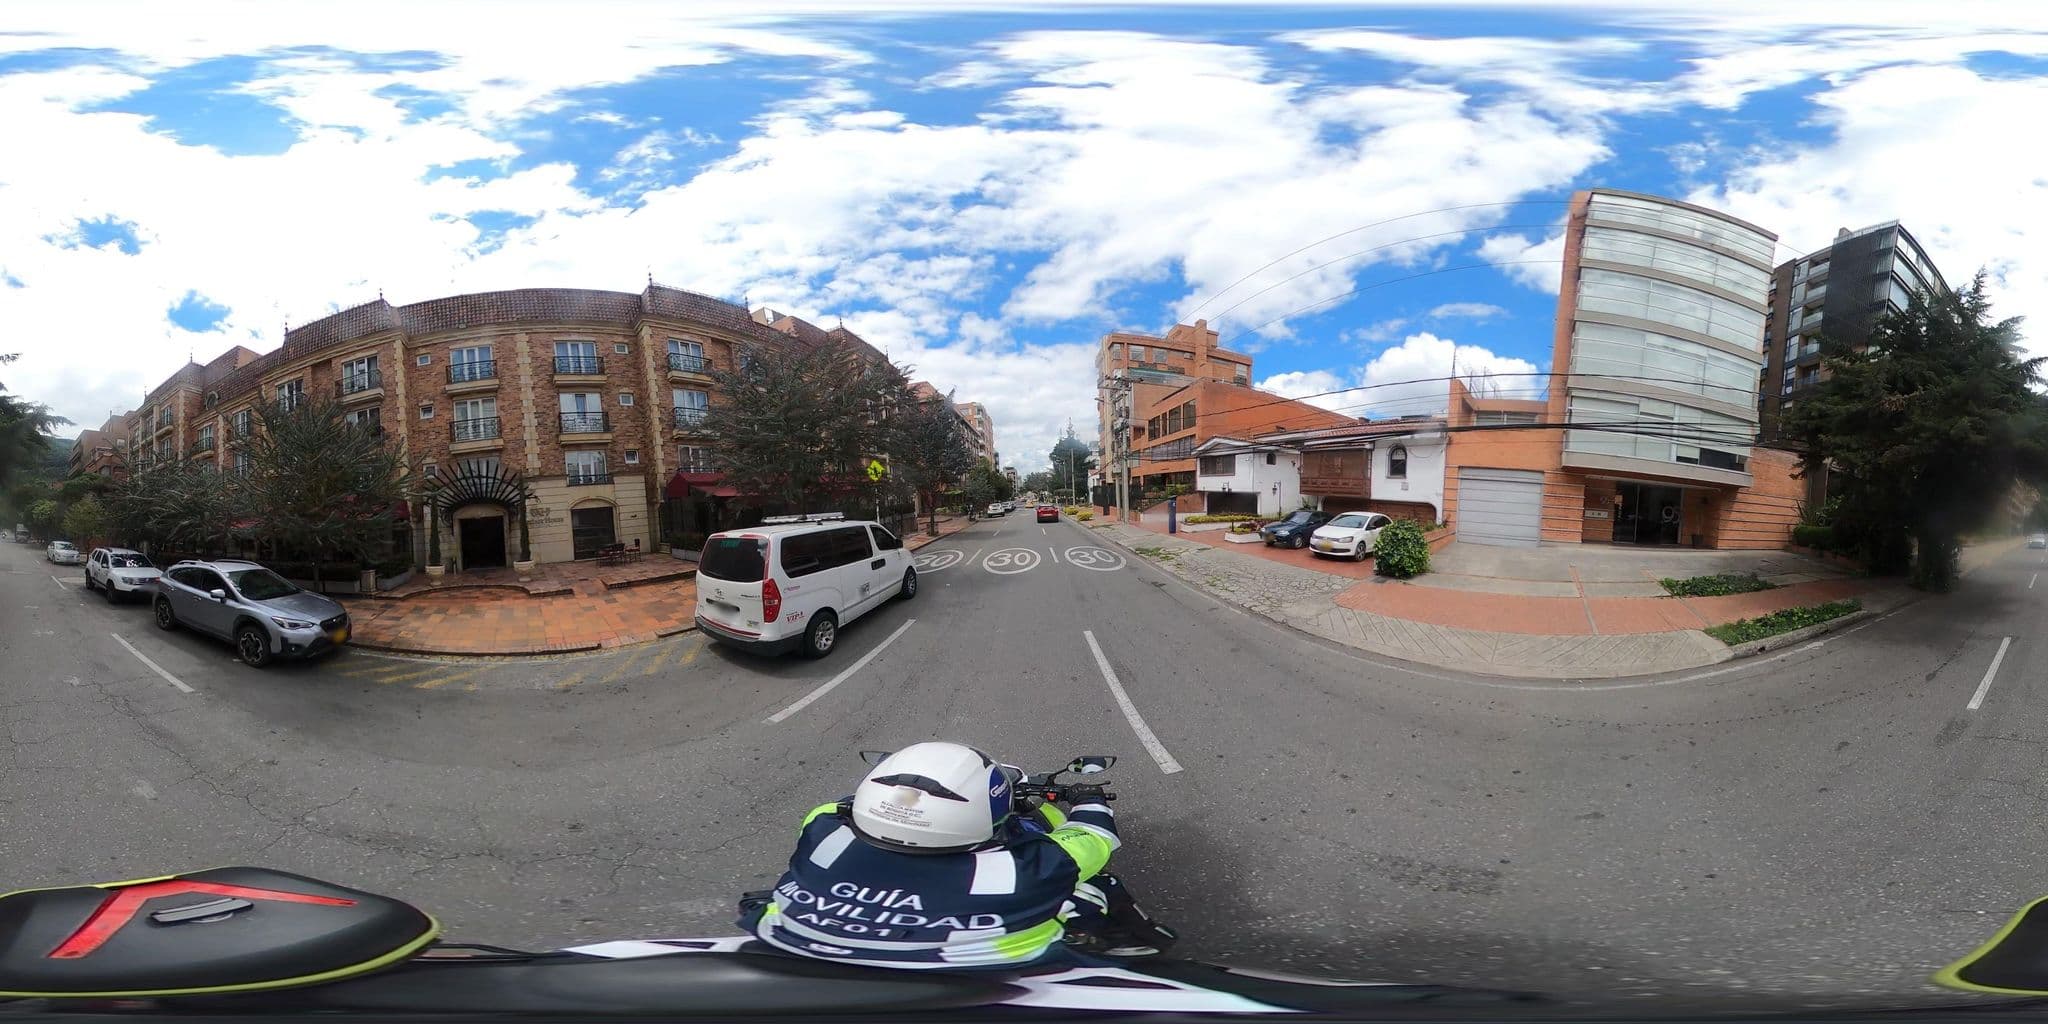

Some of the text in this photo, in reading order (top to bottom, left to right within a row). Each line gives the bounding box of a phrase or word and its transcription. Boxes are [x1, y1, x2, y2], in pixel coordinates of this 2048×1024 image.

[914, 553, 953, 567] 30
[988, 553, 1030, 567] 30
[1070, 550, 1114, 564] 30
[779, 880, 1004, 930] MOVILIDAD
[830, 882, 923, 910] GUÍA
[798, 913, 892, 937] AF01
